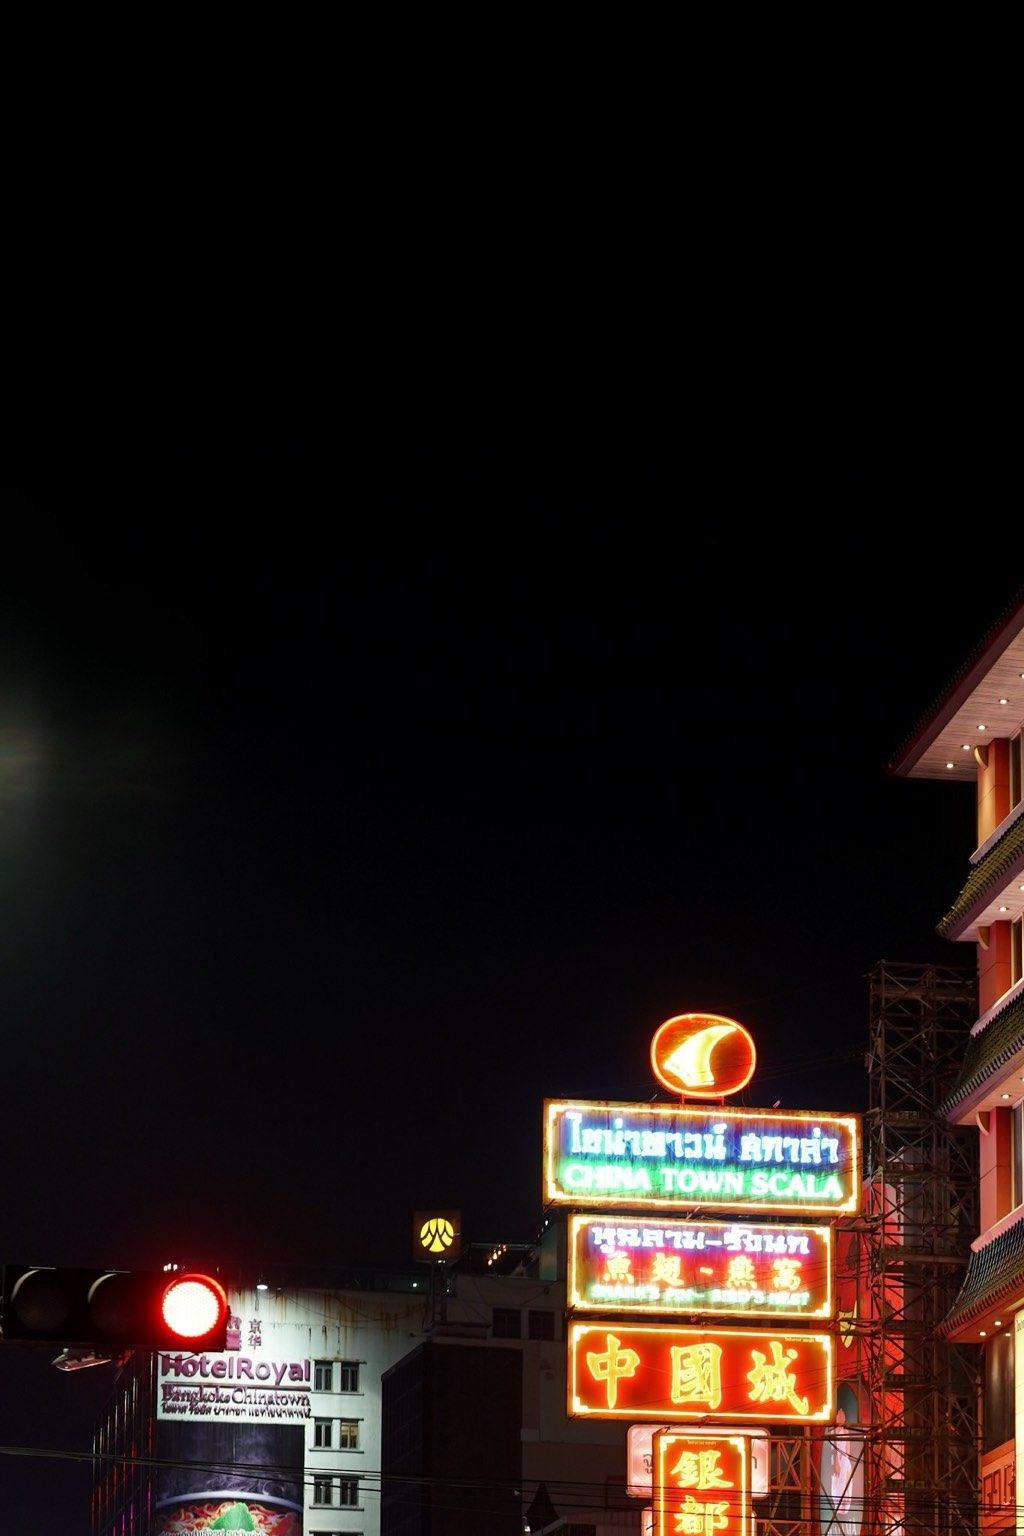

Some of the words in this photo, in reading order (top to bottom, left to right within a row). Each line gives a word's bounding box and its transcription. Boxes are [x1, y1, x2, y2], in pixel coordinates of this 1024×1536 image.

[565, 1112, 728, 1159] ไชน่าทาวน์
[740, 1127, 840, 1163] สกาล่า
[563, 1163, 651, 1189] CHINA
[660, 1167, 745, 1195] TOWN
[751, 1170, 843, 1198] SCALA
[586, 1333, 809, 1415] 中國城
